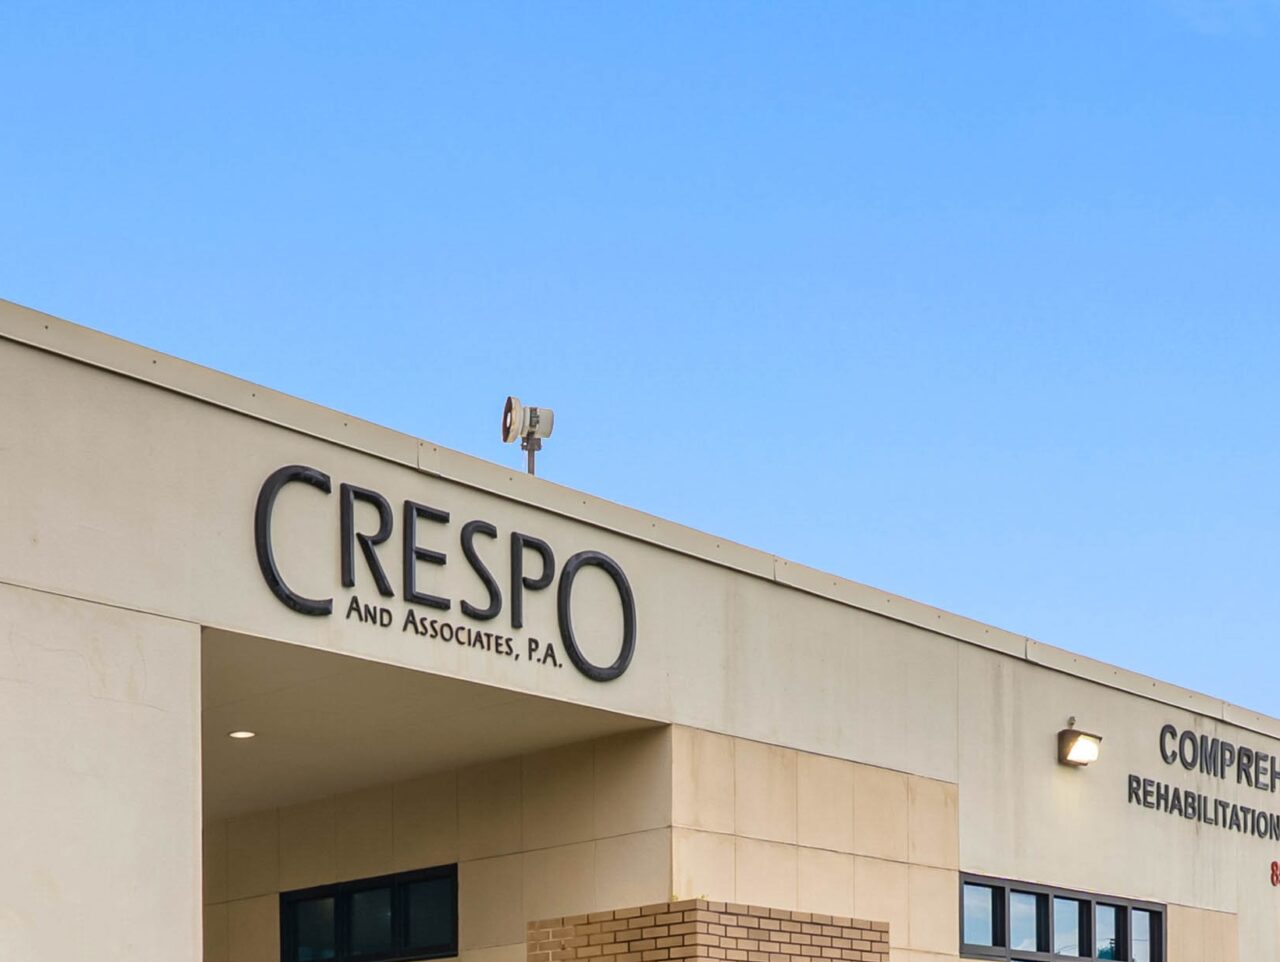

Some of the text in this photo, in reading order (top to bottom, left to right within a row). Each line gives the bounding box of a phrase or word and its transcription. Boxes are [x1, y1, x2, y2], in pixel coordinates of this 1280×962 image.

[255, 464, 637, 682] CRESPO
[346, 596, 563, 669] AND ASSOCIATES, P.A.
[1128, 774, 1280, 841] REHABILITATION
